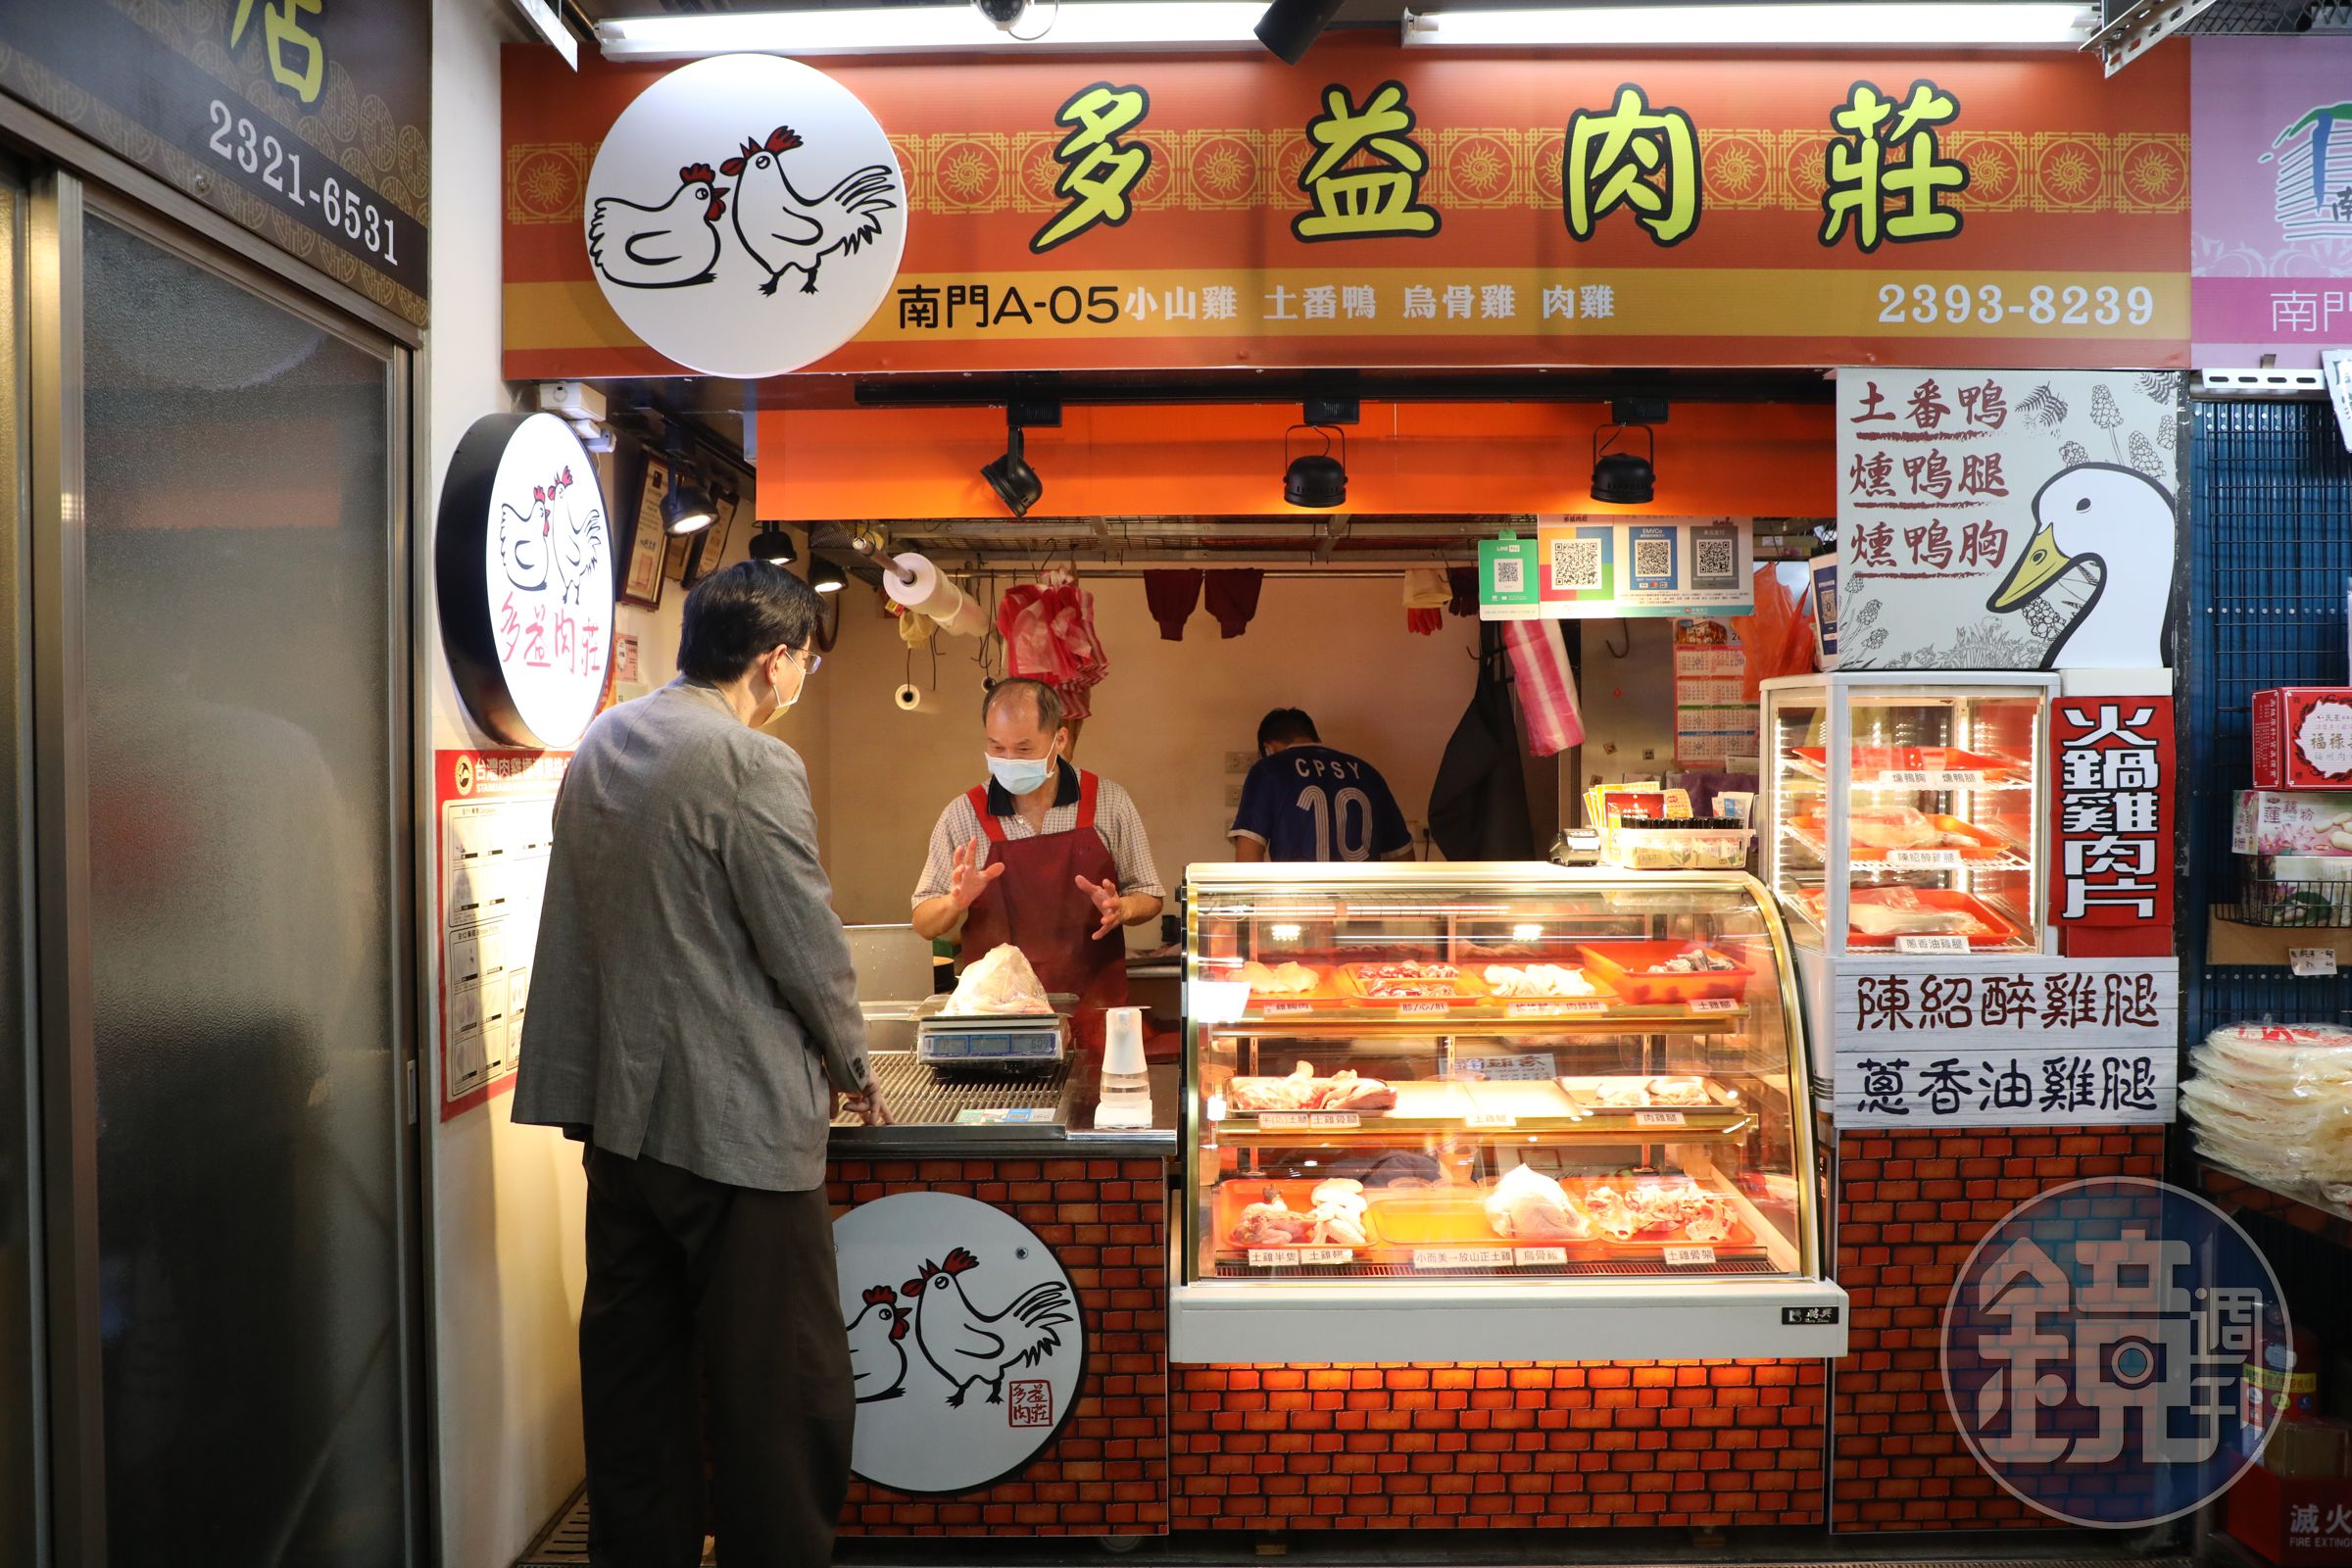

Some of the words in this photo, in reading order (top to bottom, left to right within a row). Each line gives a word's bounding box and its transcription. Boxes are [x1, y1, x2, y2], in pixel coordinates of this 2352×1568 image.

[210, 101, 398, 267] 2321-6531
[1031, 82, 1963, 252] 多益肉莊
[898, 284, 1119, 328] 南門A-05
[1124, 285, 1238, 320] 小山雞
[1263, 284, 1377, 319] 土番鴨
[1402, 284, 1516, 319] 烏骨雞
[1543, 284, 1615, 319] 肉雞
[1879, 284, 2153, 324] 2393-8239
[1850, 378, 2008, 429] 土番鴨
[1849, 448, 2009, 499] 燻鴨腿
[1850, 518, 2009, 569] 燻鴨胸
[501, 591, 600, 676] 多益肉莊
[2311, 732, 2352, 750] 福祿
[1295, 758, 1360, 780] CPSY
[1296, 786, 1372, 862] 10
[2061, 704, 2160, 919] 火鍋雞肉片
[1857, 972, 2159, 1031] 陳紹醉雞腿
[1857, 1056, 2158, 1116] 蔥香油雞腿
[2289, 1537, 2311, 1547] FIRE
[2315, 1537, 2352, 1547] EXTING
[2290, 1503, 2352, 1535] 滅火
